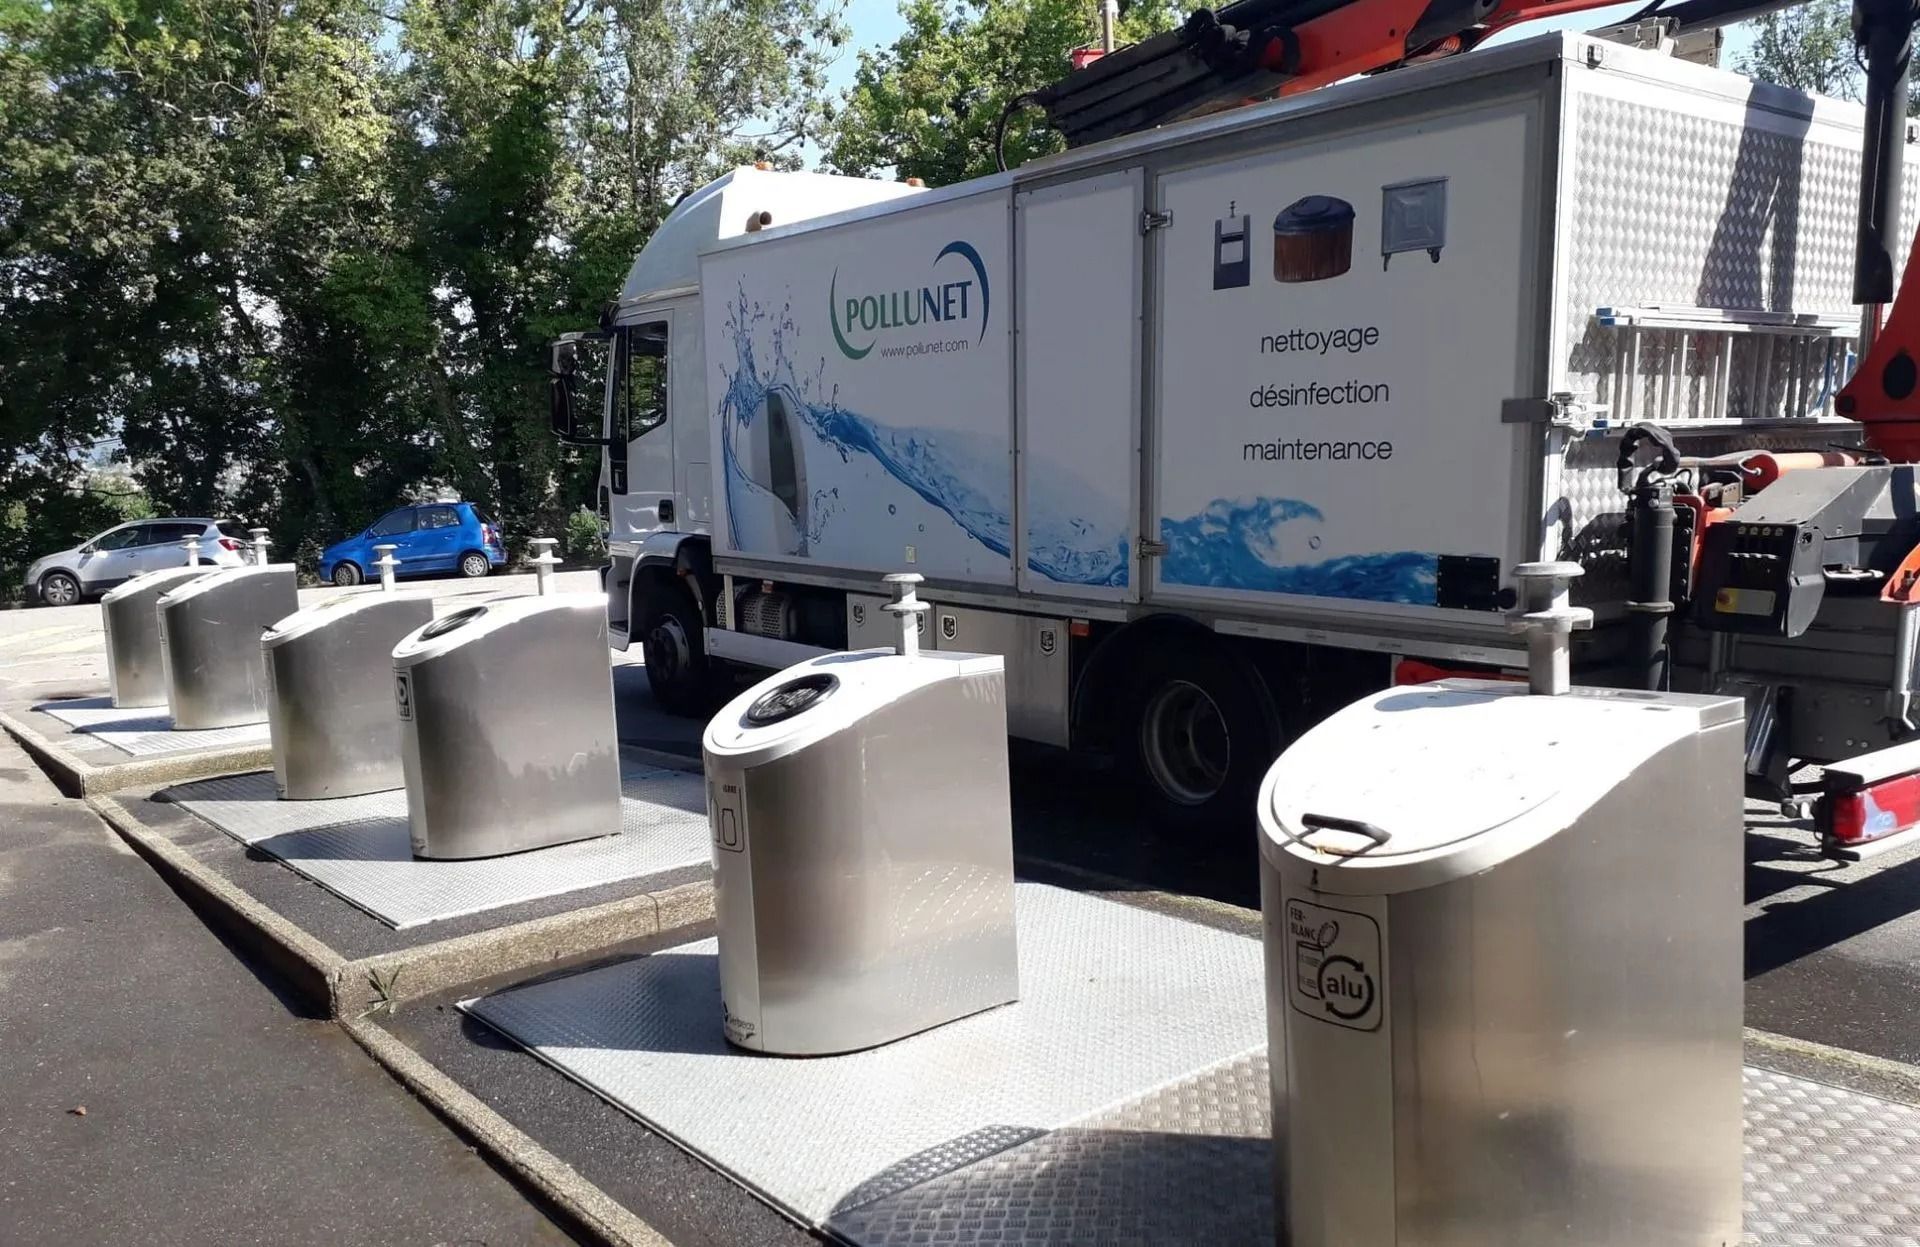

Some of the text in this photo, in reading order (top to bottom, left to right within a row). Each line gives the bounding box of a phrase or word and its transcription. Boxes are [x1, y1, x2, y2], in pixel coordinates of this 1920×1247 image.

[846, 280, 972, 333] POLLUNET
[881, 338, 968, 359] www.pollunet.com
[1261, 326, 1379, 355] nettoyage
[1250, 379, 1389, 408] désinfection
[1243, 437, 1393, 461] maintenance
[1291, 922, 1315, 941] BLANC
[1326, 974, 1363, 1000] alu
